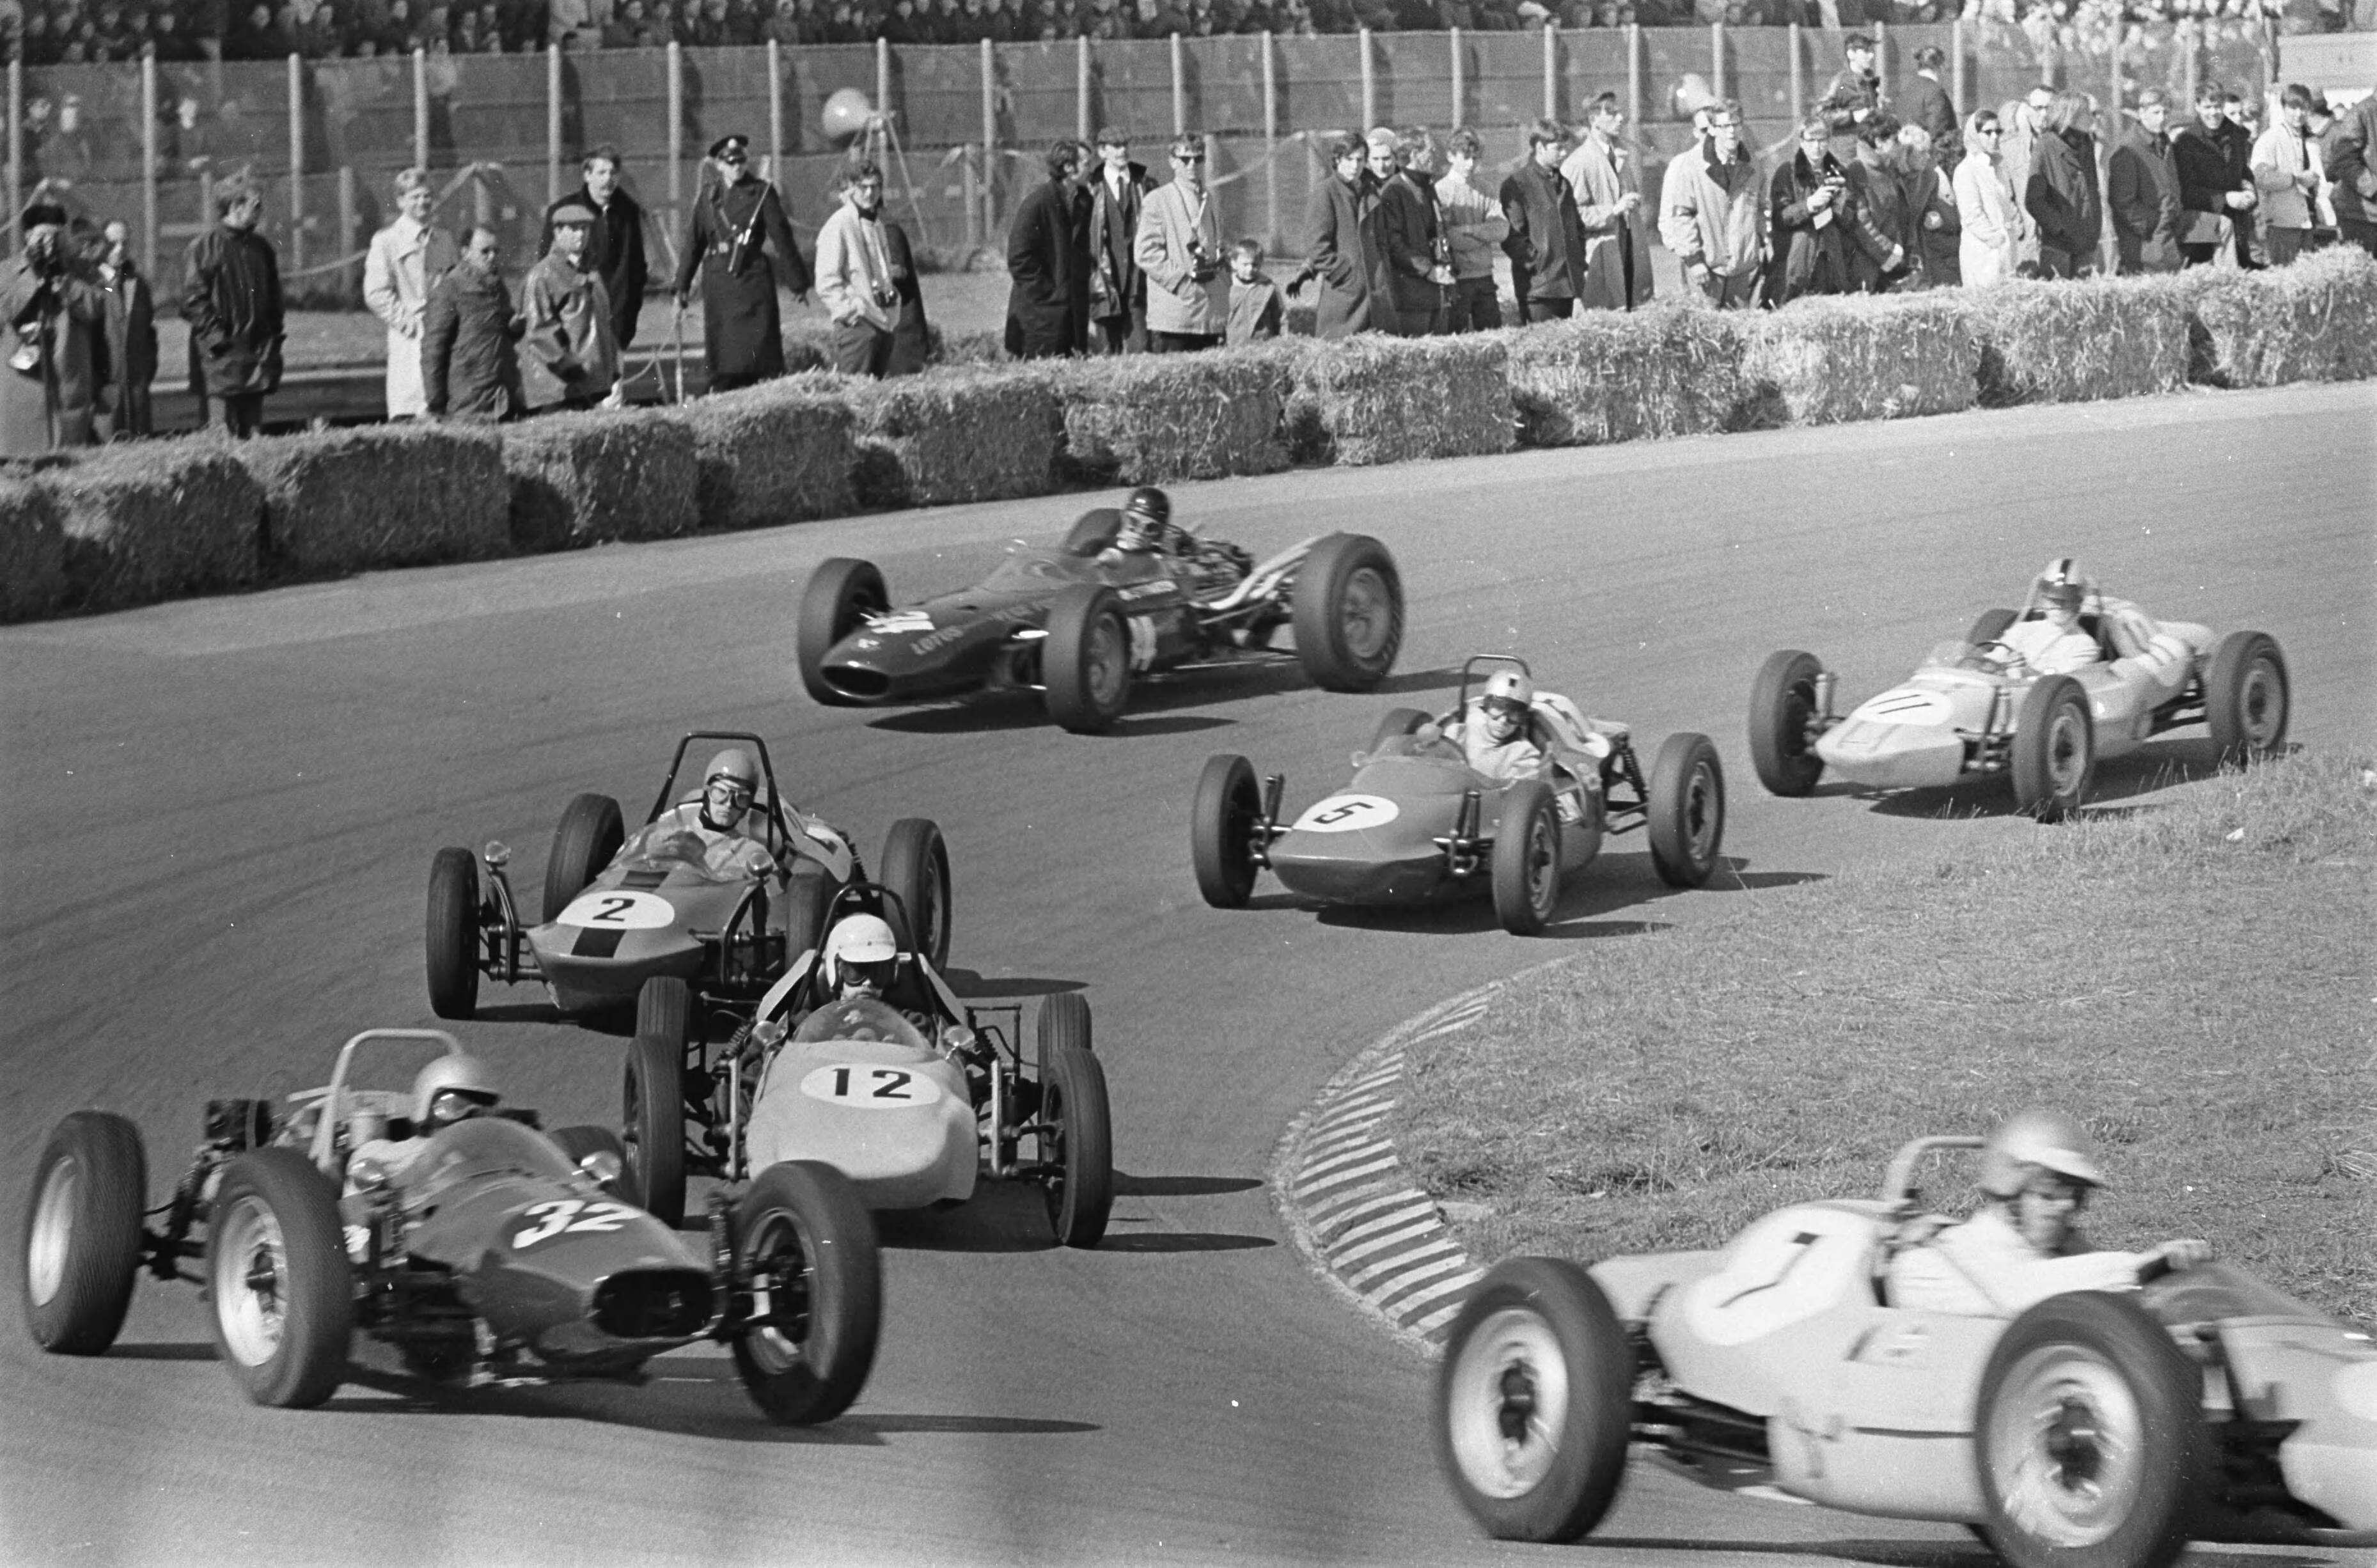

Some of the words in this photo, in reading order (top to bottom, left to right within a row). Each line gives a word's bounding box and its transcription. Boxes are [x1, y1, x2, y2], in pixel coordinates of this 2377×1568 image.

[1868, 694, 1933, 715] 11
[1313, 802, 1375, 824] 5
[592, 898, 636, 922] 2
[832, 1068, 912, 1099] 12
[512, 1199, 645, 1250] 32
